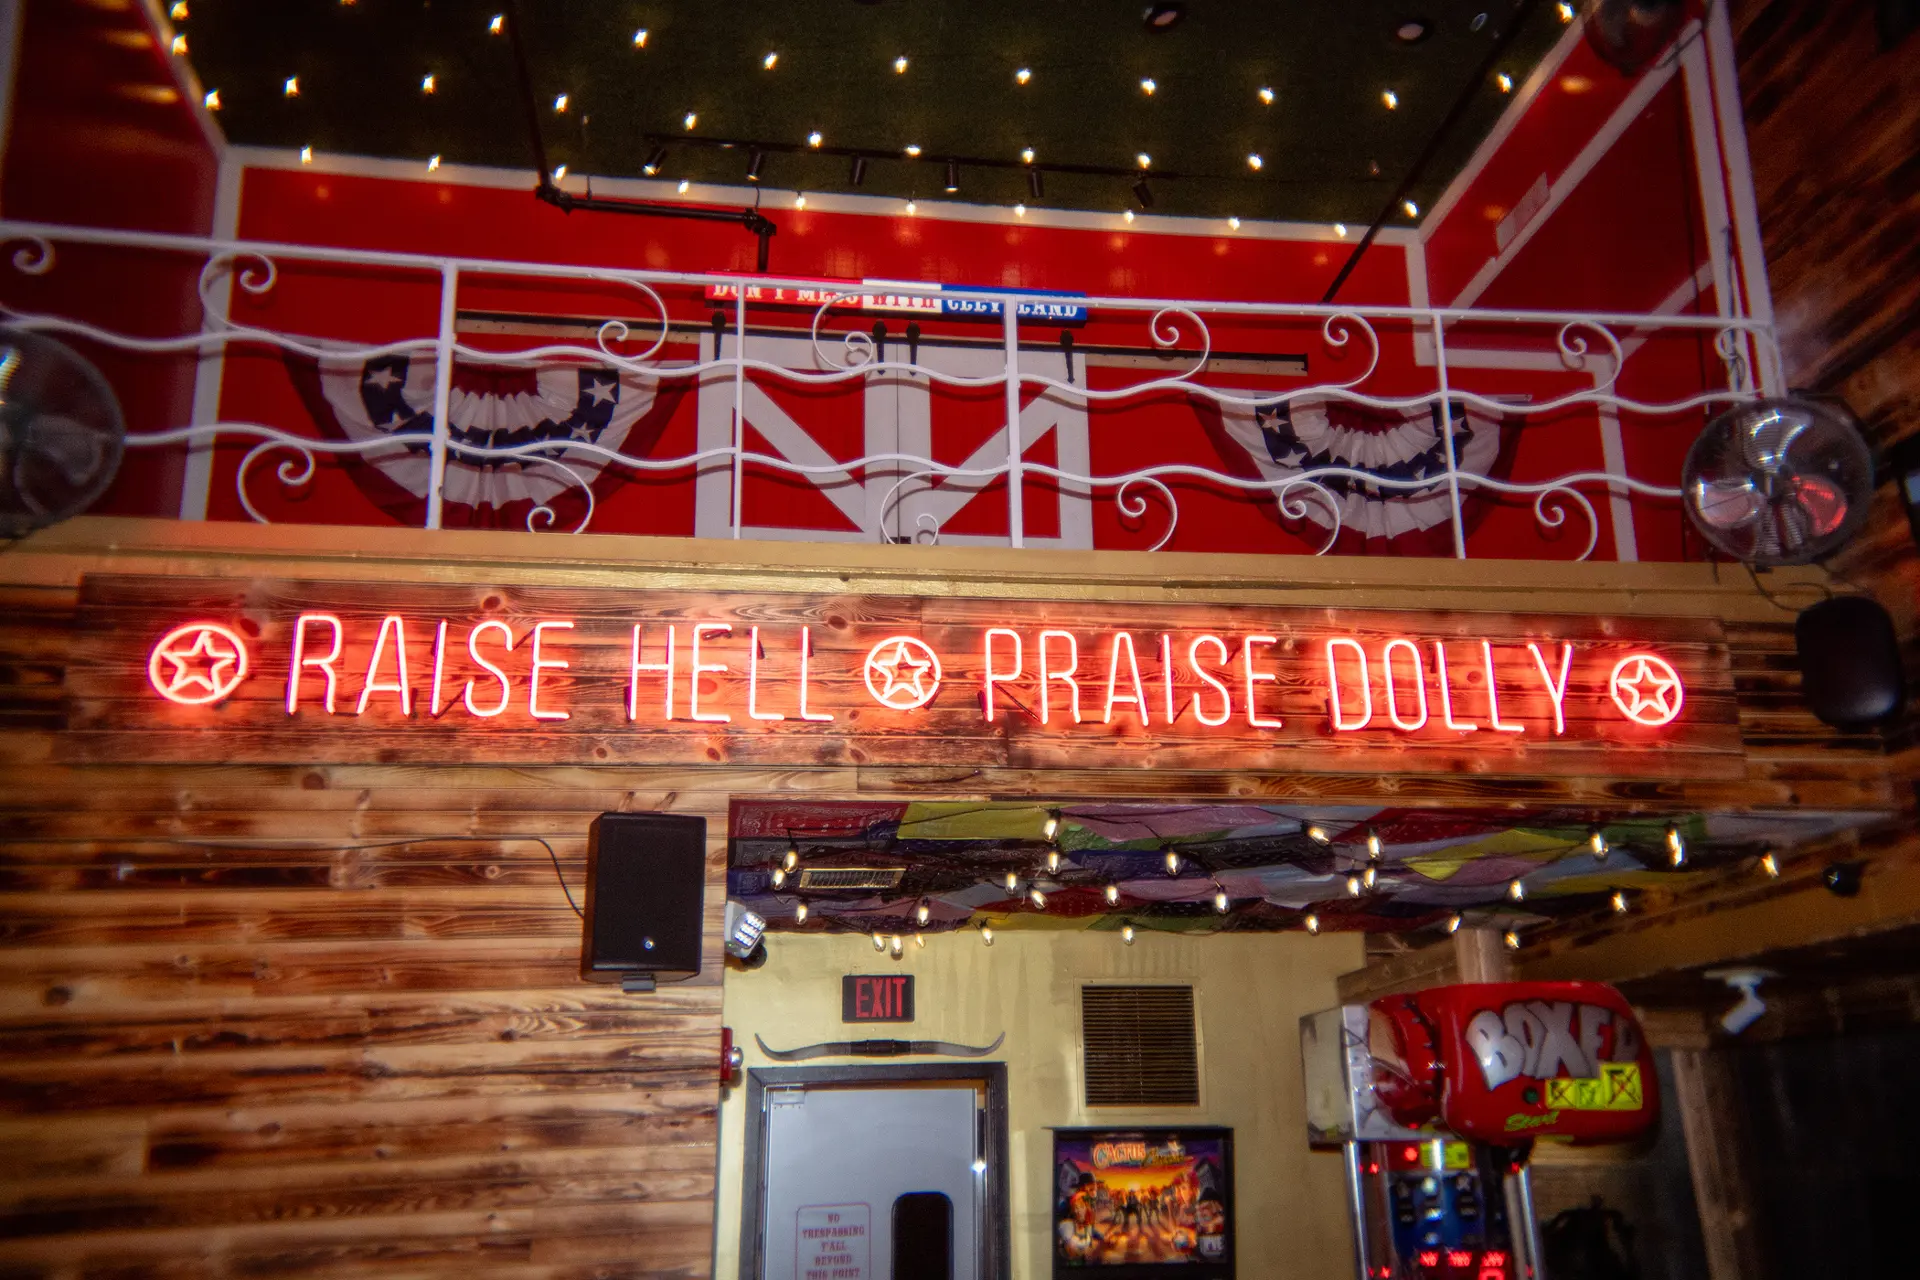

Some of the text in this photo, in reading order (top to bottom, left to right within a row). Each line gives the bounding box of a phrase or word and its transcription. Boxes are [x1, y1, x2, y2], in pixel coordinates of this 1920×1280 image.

[947, 299, 1078, 317] CLEVLAND
[286, 614, 1573, 735] RAISE HELL PRAISE DOLLY
[856, 977, 906, 1018] EXIT
[827, 1213, 840, 1223] NO
[802, 1226, 865, 1239] TRESPASSING
[815, 1254, 852, 1266] BEYOND
[806, 1267, 861, 1280] THIS POINT
